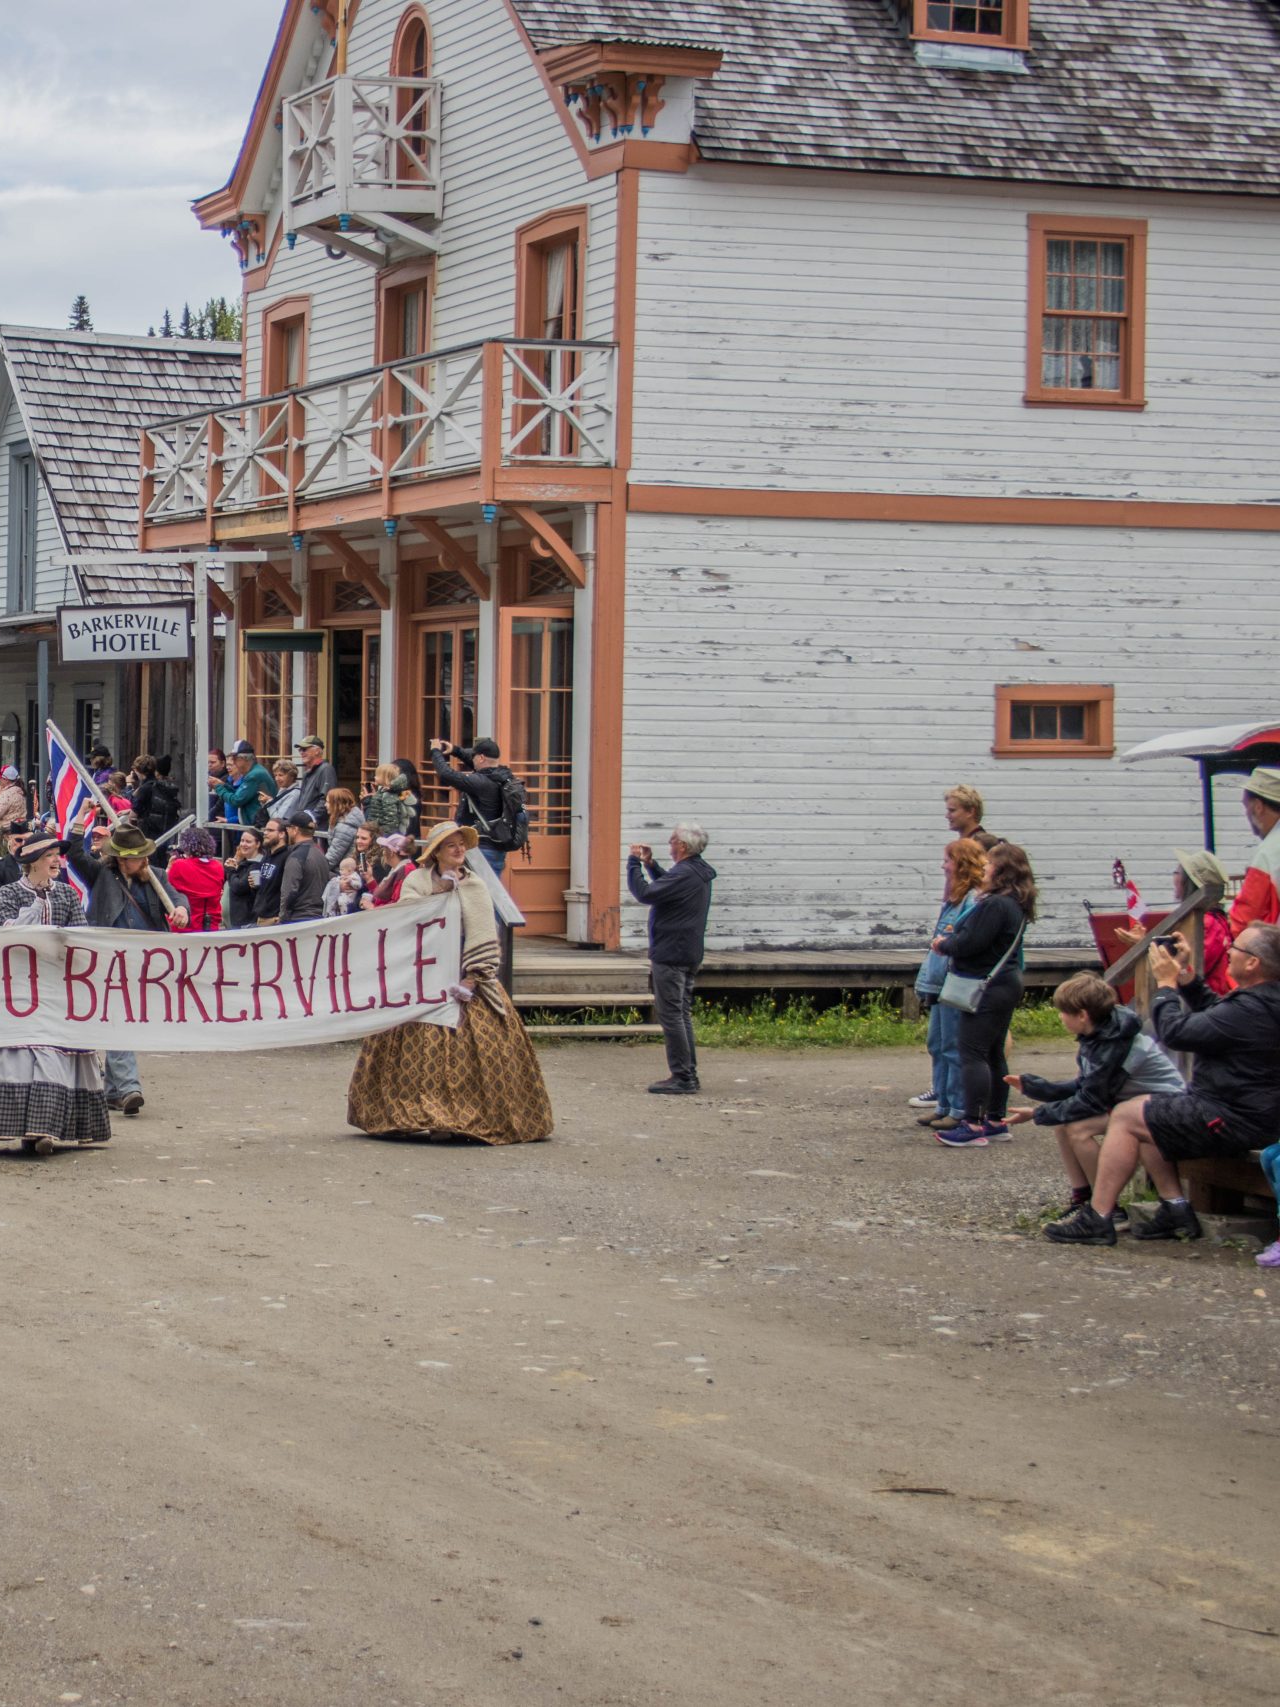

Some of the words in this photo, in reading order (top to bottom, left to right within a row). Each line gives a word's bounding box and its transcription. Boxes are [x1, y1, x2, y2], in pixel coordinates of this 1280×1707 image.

[67, 613, 181, 640] BARKERVILLE
[91, 633, 162, 652] HOTEL
[63, 917, 448, 1023] BARKERVILLE
